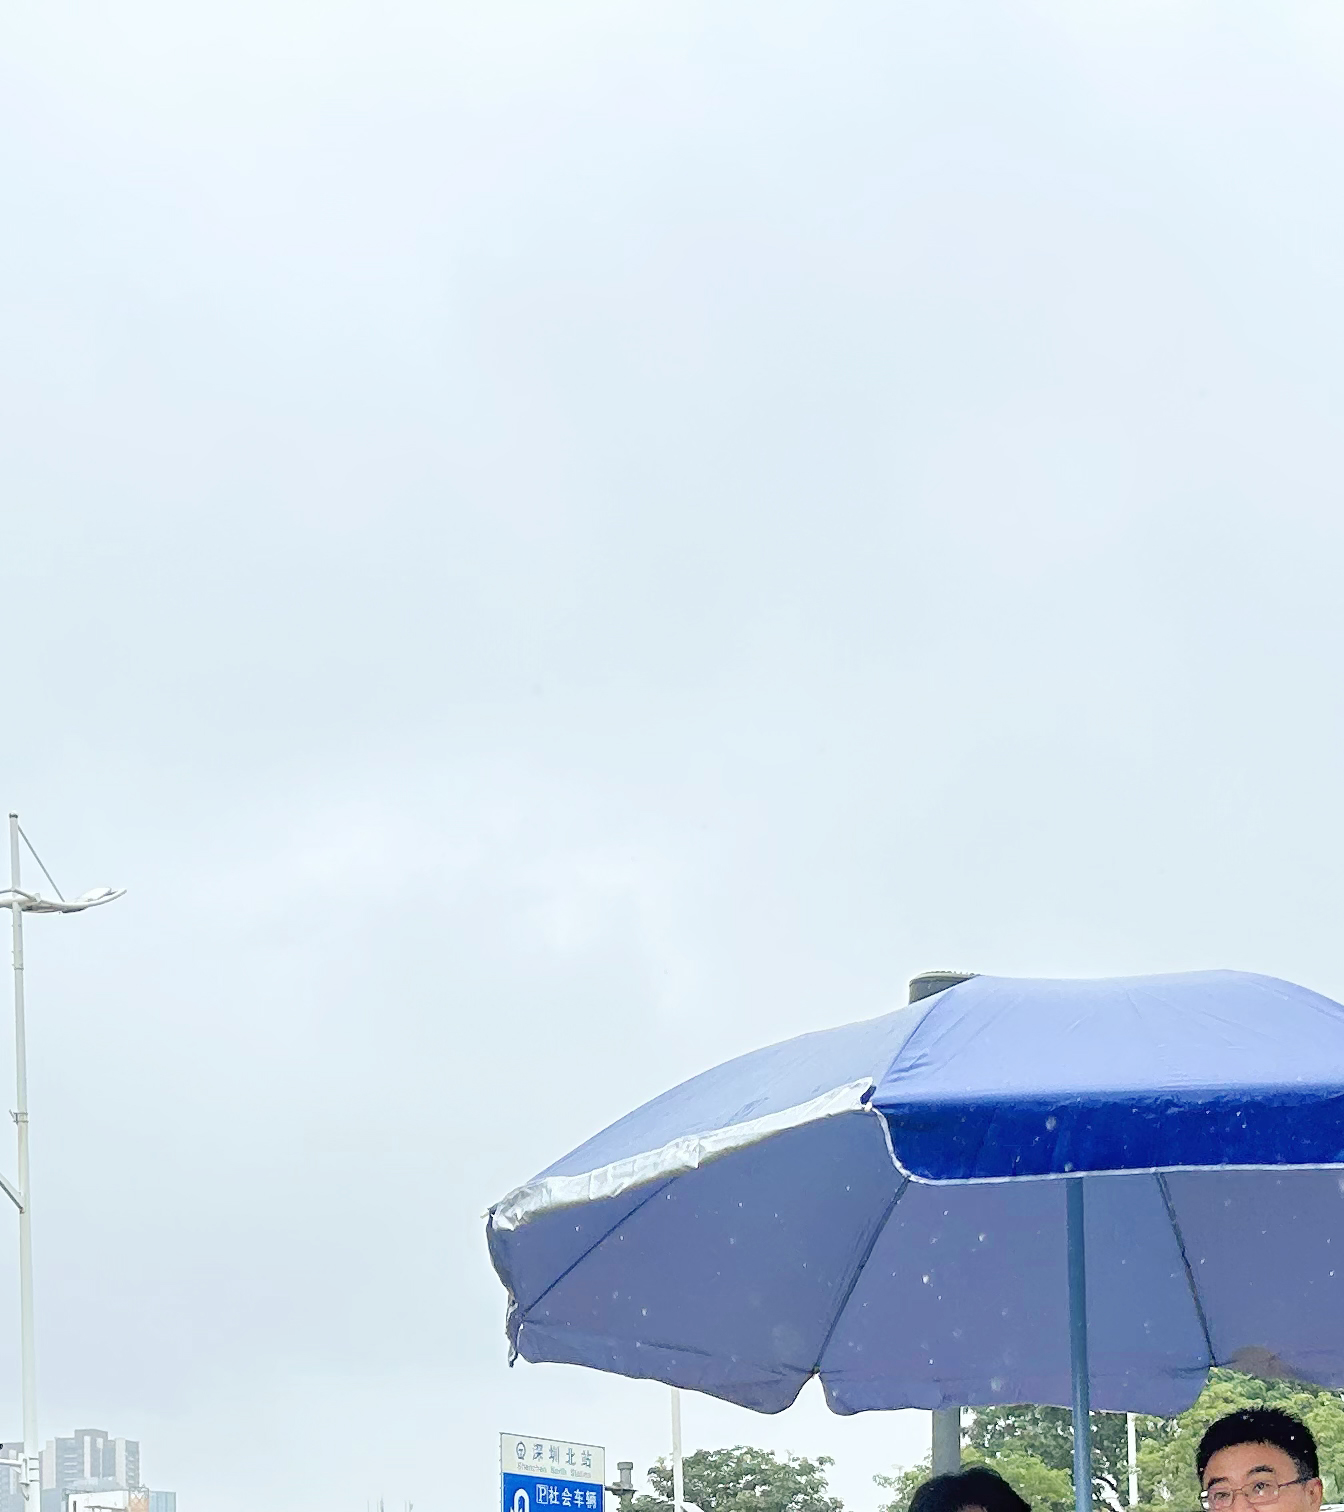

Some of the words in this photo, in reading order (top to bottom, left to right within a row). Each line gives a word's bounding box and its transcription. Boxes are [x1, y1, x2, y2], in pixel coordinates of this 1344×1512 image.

[532, 1443, 592, 1468] 深圳北站
[548, 1486, 597, 1509] 社会车辆
